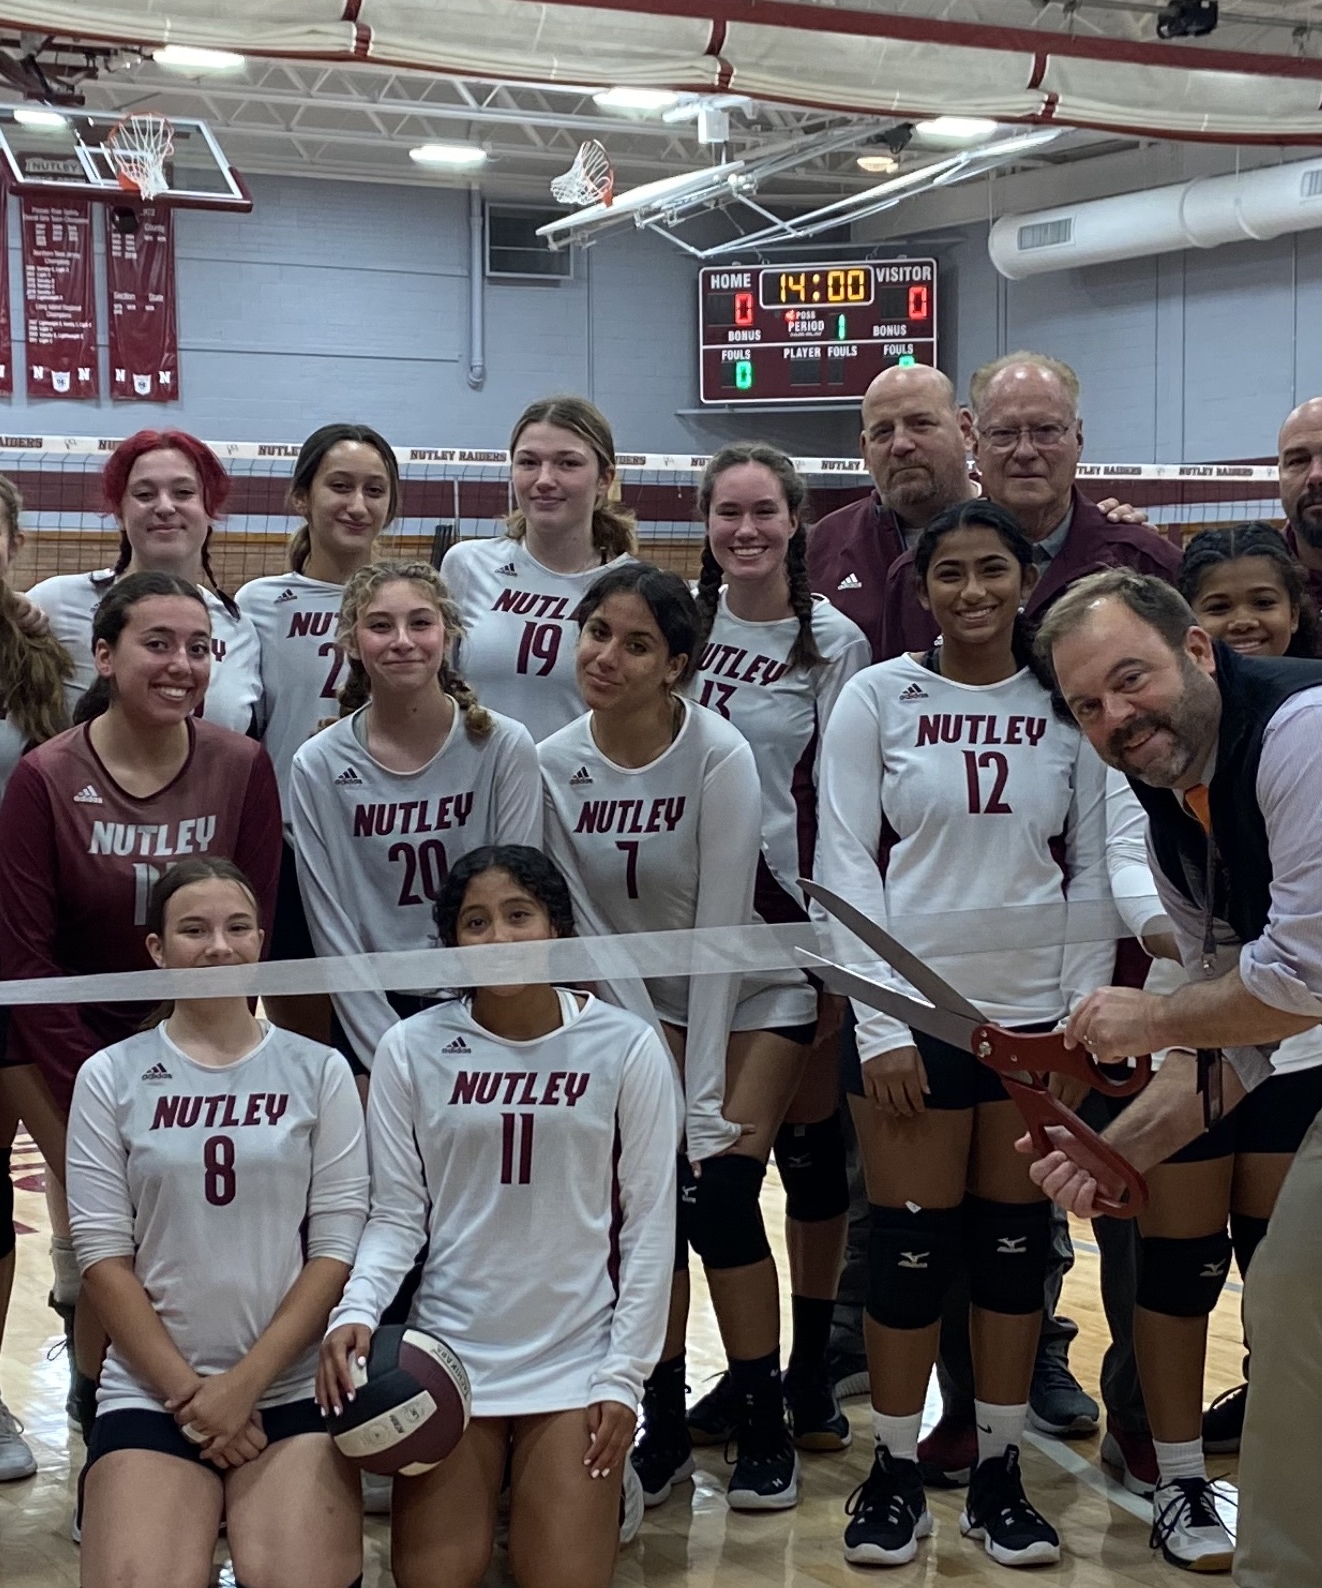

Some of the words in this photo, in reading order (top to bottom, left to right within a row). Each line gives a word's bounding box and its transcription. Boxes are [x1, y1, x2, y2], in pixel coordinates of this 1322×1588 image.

[32, 163, 78, 173] NUTLEY
[710, 273, 752, 289] HOME
[875, 265, 932, 283] VISITOR
[779, 269, 865, 303] 14:00
[734, 292, 754, 326] 0
[908, 285, 928, 320] 0
[796, 310, 816, 320] POSS
[788, 320, 825, 332] PERIOD
[873, 324, 907, 337] BONUS
[728, 330, 762, 342] BONUS
[721, 349, 752, 361] FOULS
[783, 347, 822, 359] PLAYER
[827, 345, 858, 358] FOULS
[883, 343, 914, 355] FOULS
[33, 365, 45, 379] N
[78, 367, 91, 381] N
[115, 368, 127, 382] N
[159, 370, 172, 384] N
[735, 360, 753, 390] 0
[258, 445, 302, 457] NUTLE
[410, 449, 455, 461] NUTLEY
[459, 450, 507, 462] RAIDERS
[821, 460, 861, 471] NUTLEY
[1077, 466, 1101, 476] TLEY
[1179, 467, 1214, 477] NUTLEY
[516, 621, 563, 677] 19
[697, 642, 788, 686] UTLEY
[914, 713, 1048, 748] NUTLEY
[960, 749, 1013, 815] 12
[353, 790, 475, 839] NUTLEY
[572, 796, 687, 834] NUTLEY
[87, 814, 217, 857] NUTLEY
[387, 839, 448, 907] 20
[616, 840, 640, 900] 7
[447, 1070, 591, 1108] NUTLEY
[148, 1092, 289, 1131] NUTLEY
[499, 1111, 536, 1186] 11
[202, 1135, 237, 1207] 8
